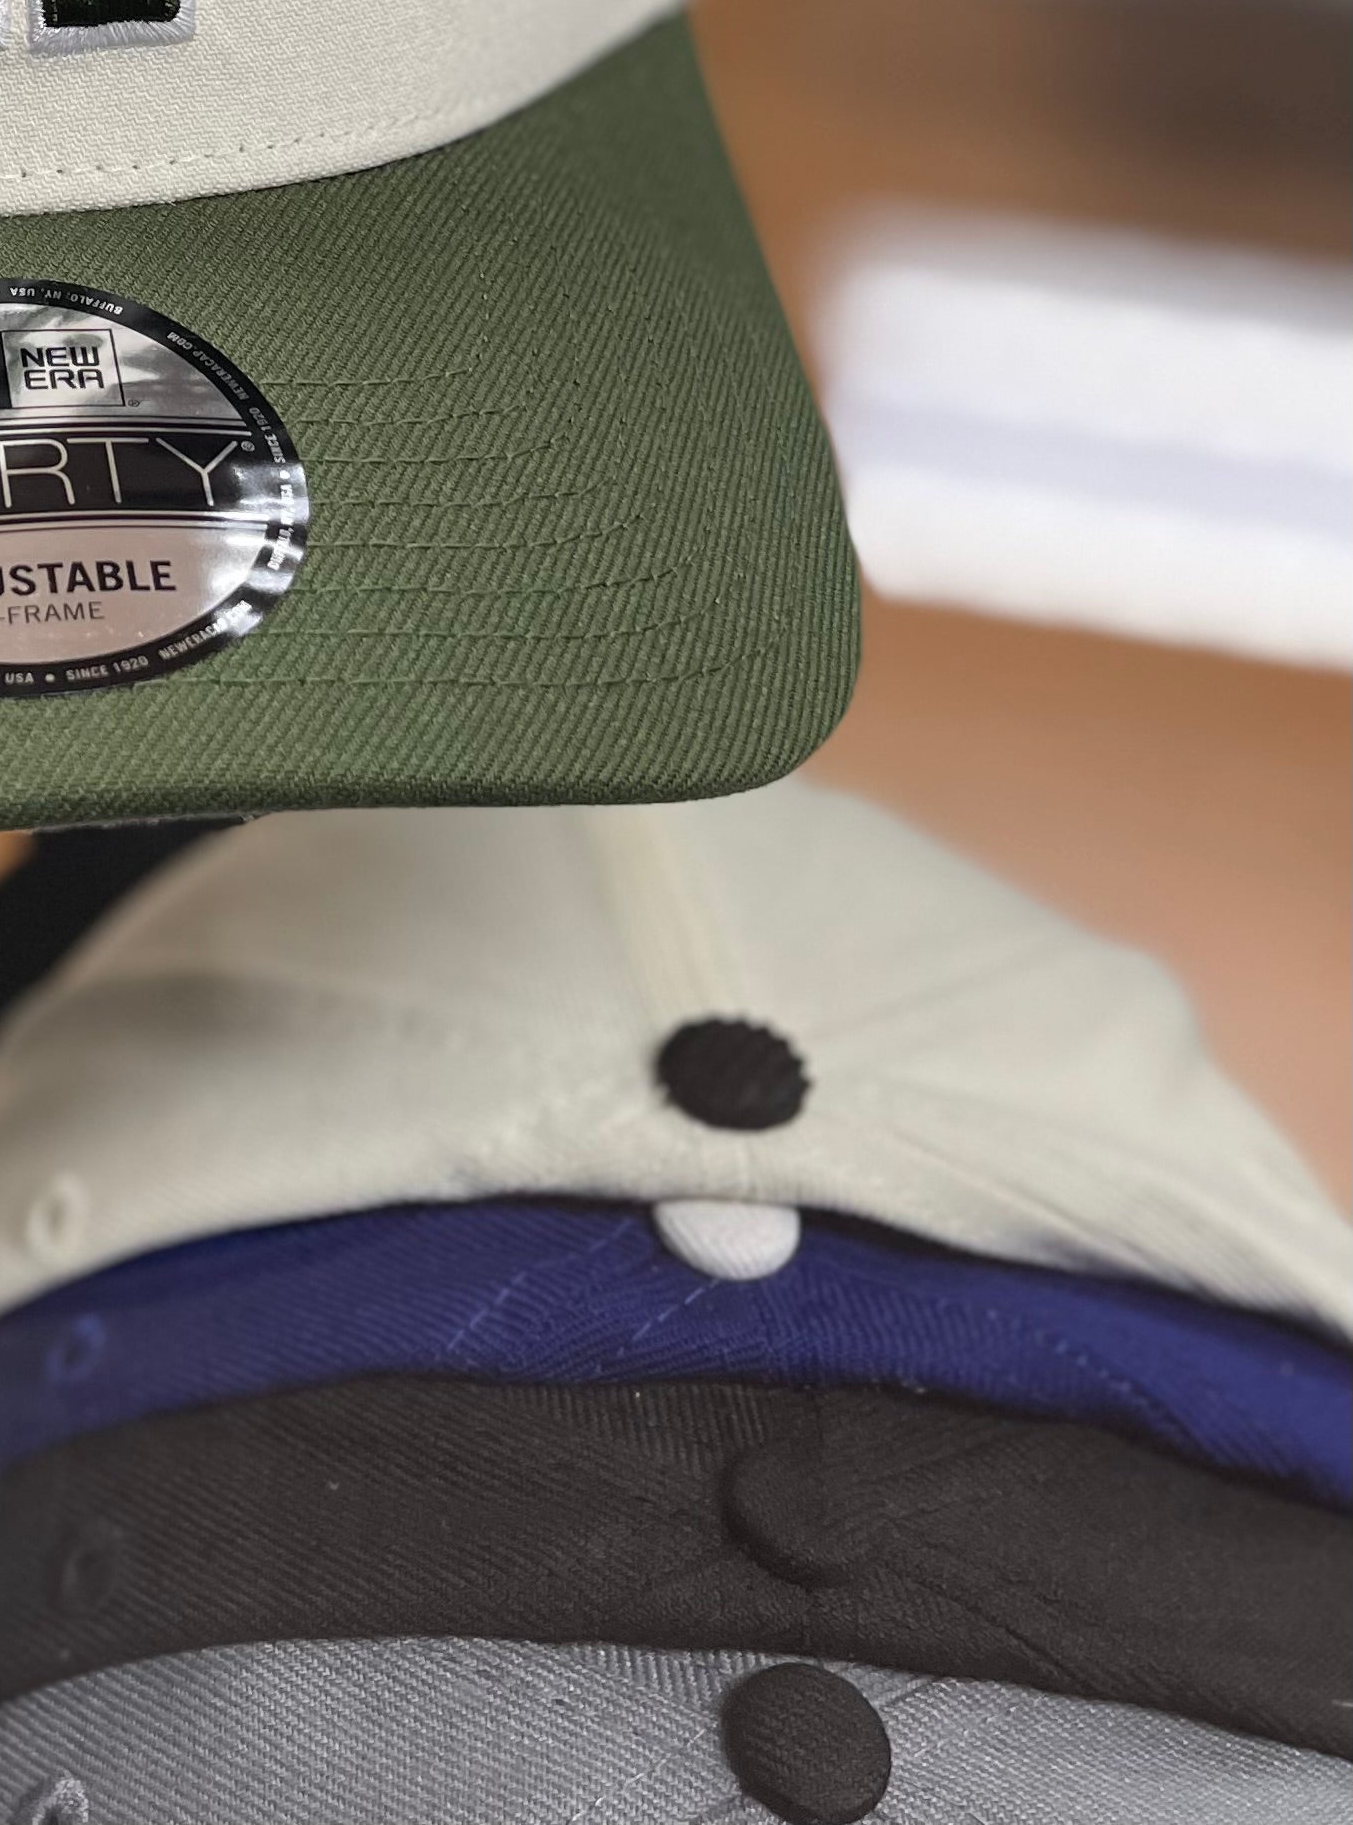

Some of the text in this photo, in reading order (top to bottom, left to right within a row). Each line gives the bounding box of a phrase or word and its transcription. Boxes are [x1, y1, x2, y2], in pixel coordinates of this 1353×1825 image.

[9, 287, 36, 297] USA
[67, 291, 124, 315] BUFFALO,
[20, 345, 101, 368] NEW
[166, 331, 250, 401] NEWERACAP.COM
[24, 368, 105, 391] ERA
[249, 407, 272, 431] 1920
[264, 433, 286, 463] SINCE
[4, 672, 34, 684] USA
[65, 664, 109, 681] SINCE
[113, 655, 149, 673] 1920
